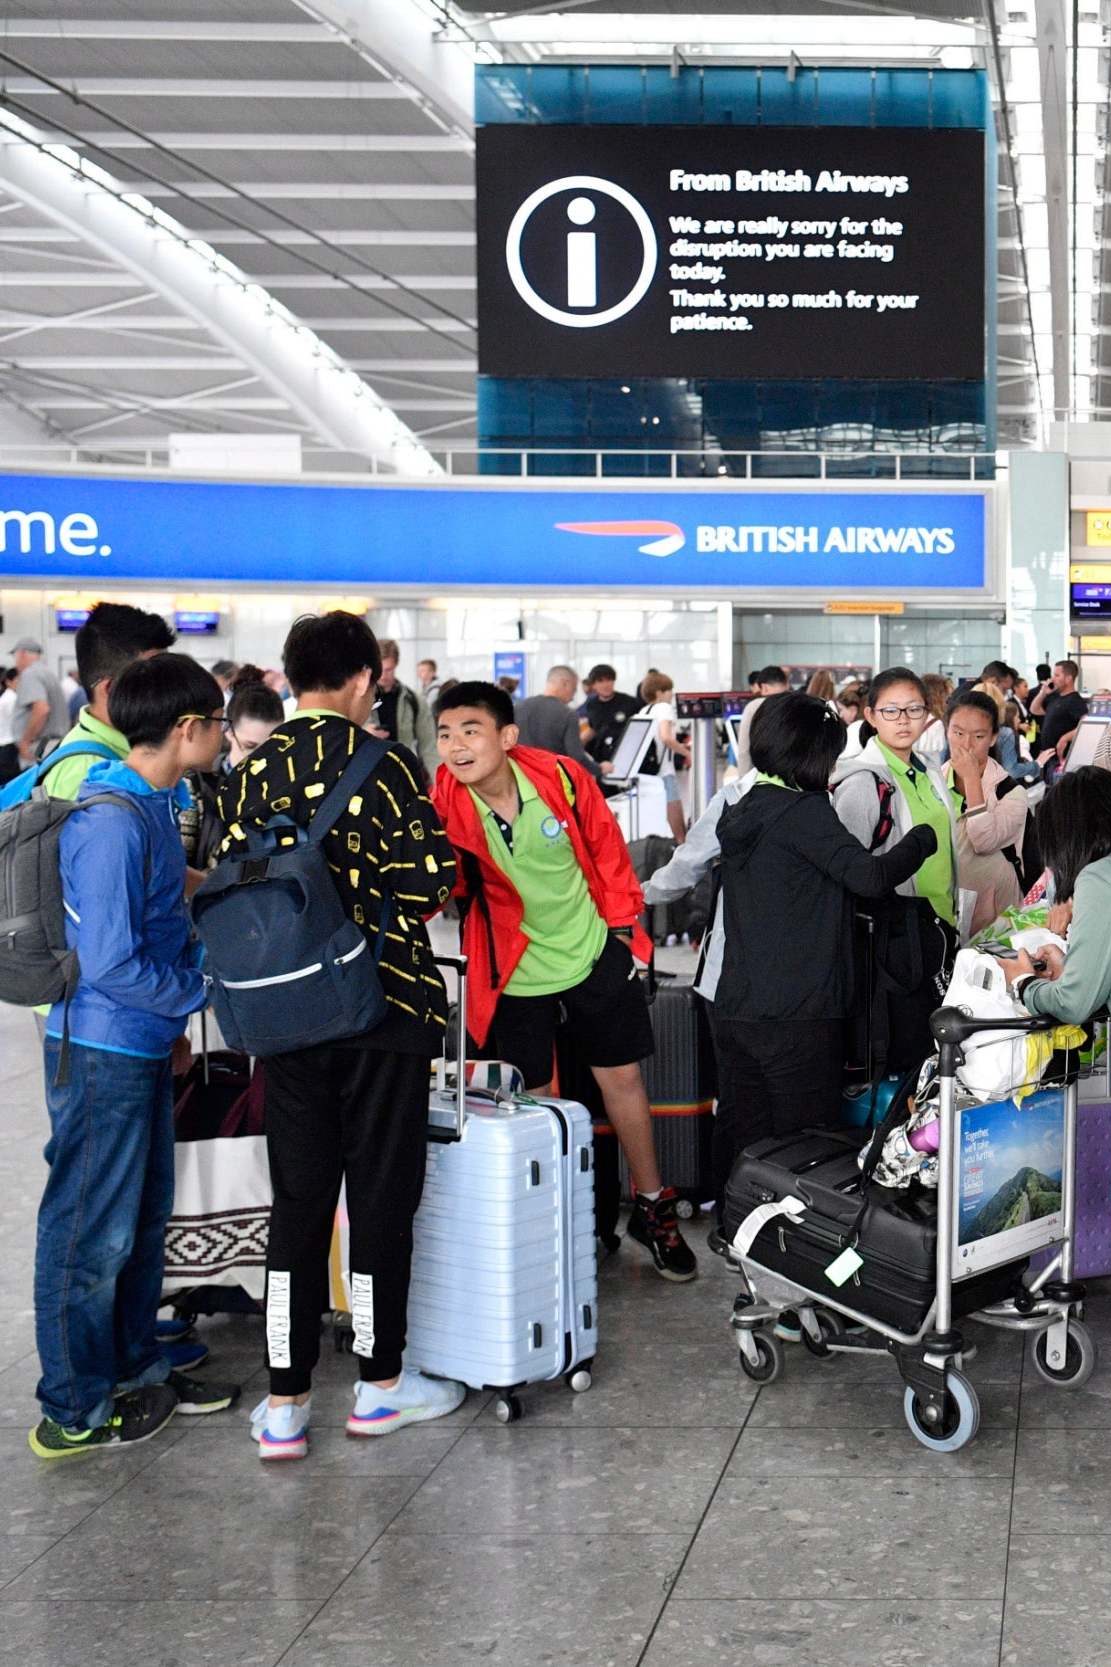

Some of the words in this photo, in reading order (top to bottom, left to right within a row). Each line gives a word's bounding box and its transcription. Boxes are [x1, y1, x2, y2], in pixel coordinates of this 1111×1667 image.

[669, 169, 731, 191] From
[736, 170, 811, 192] British
[815, 170, 909, 197] Airways
[669, 216, 700, 234] We
[704, 219, 734, 234] are
[738, 216, 789, 238] really
[791, 220, 837, 238] sorry
[839, 217, 869, 235] for
[871, 217, 903, 236] the
[670, 239, 762, 260] disruption
[765, 242, 800, 261] you
[803, 243, 834, 258] are
[837, 240, 894, 262] facing
[669, 262, 726, 284] today.
[669, 289, 727, 308] Thank
[729, 293, 764, 311] you
[768, 293, 789, 308] so
[792, 290, 842, 308] much
[845, 290, 875, 308] for
[877, 295, 919, 312] your
[670, 313, 753, 333] patience.
[697, 526, 818, 553] BRITISH
[823, 527, 955, 554] AIRWAYS
[270, 1276, 288, 1308] PAUL
[352, 1277, 371, 1308] PAUL
[269, 1314, 289, 1361] FRANK
